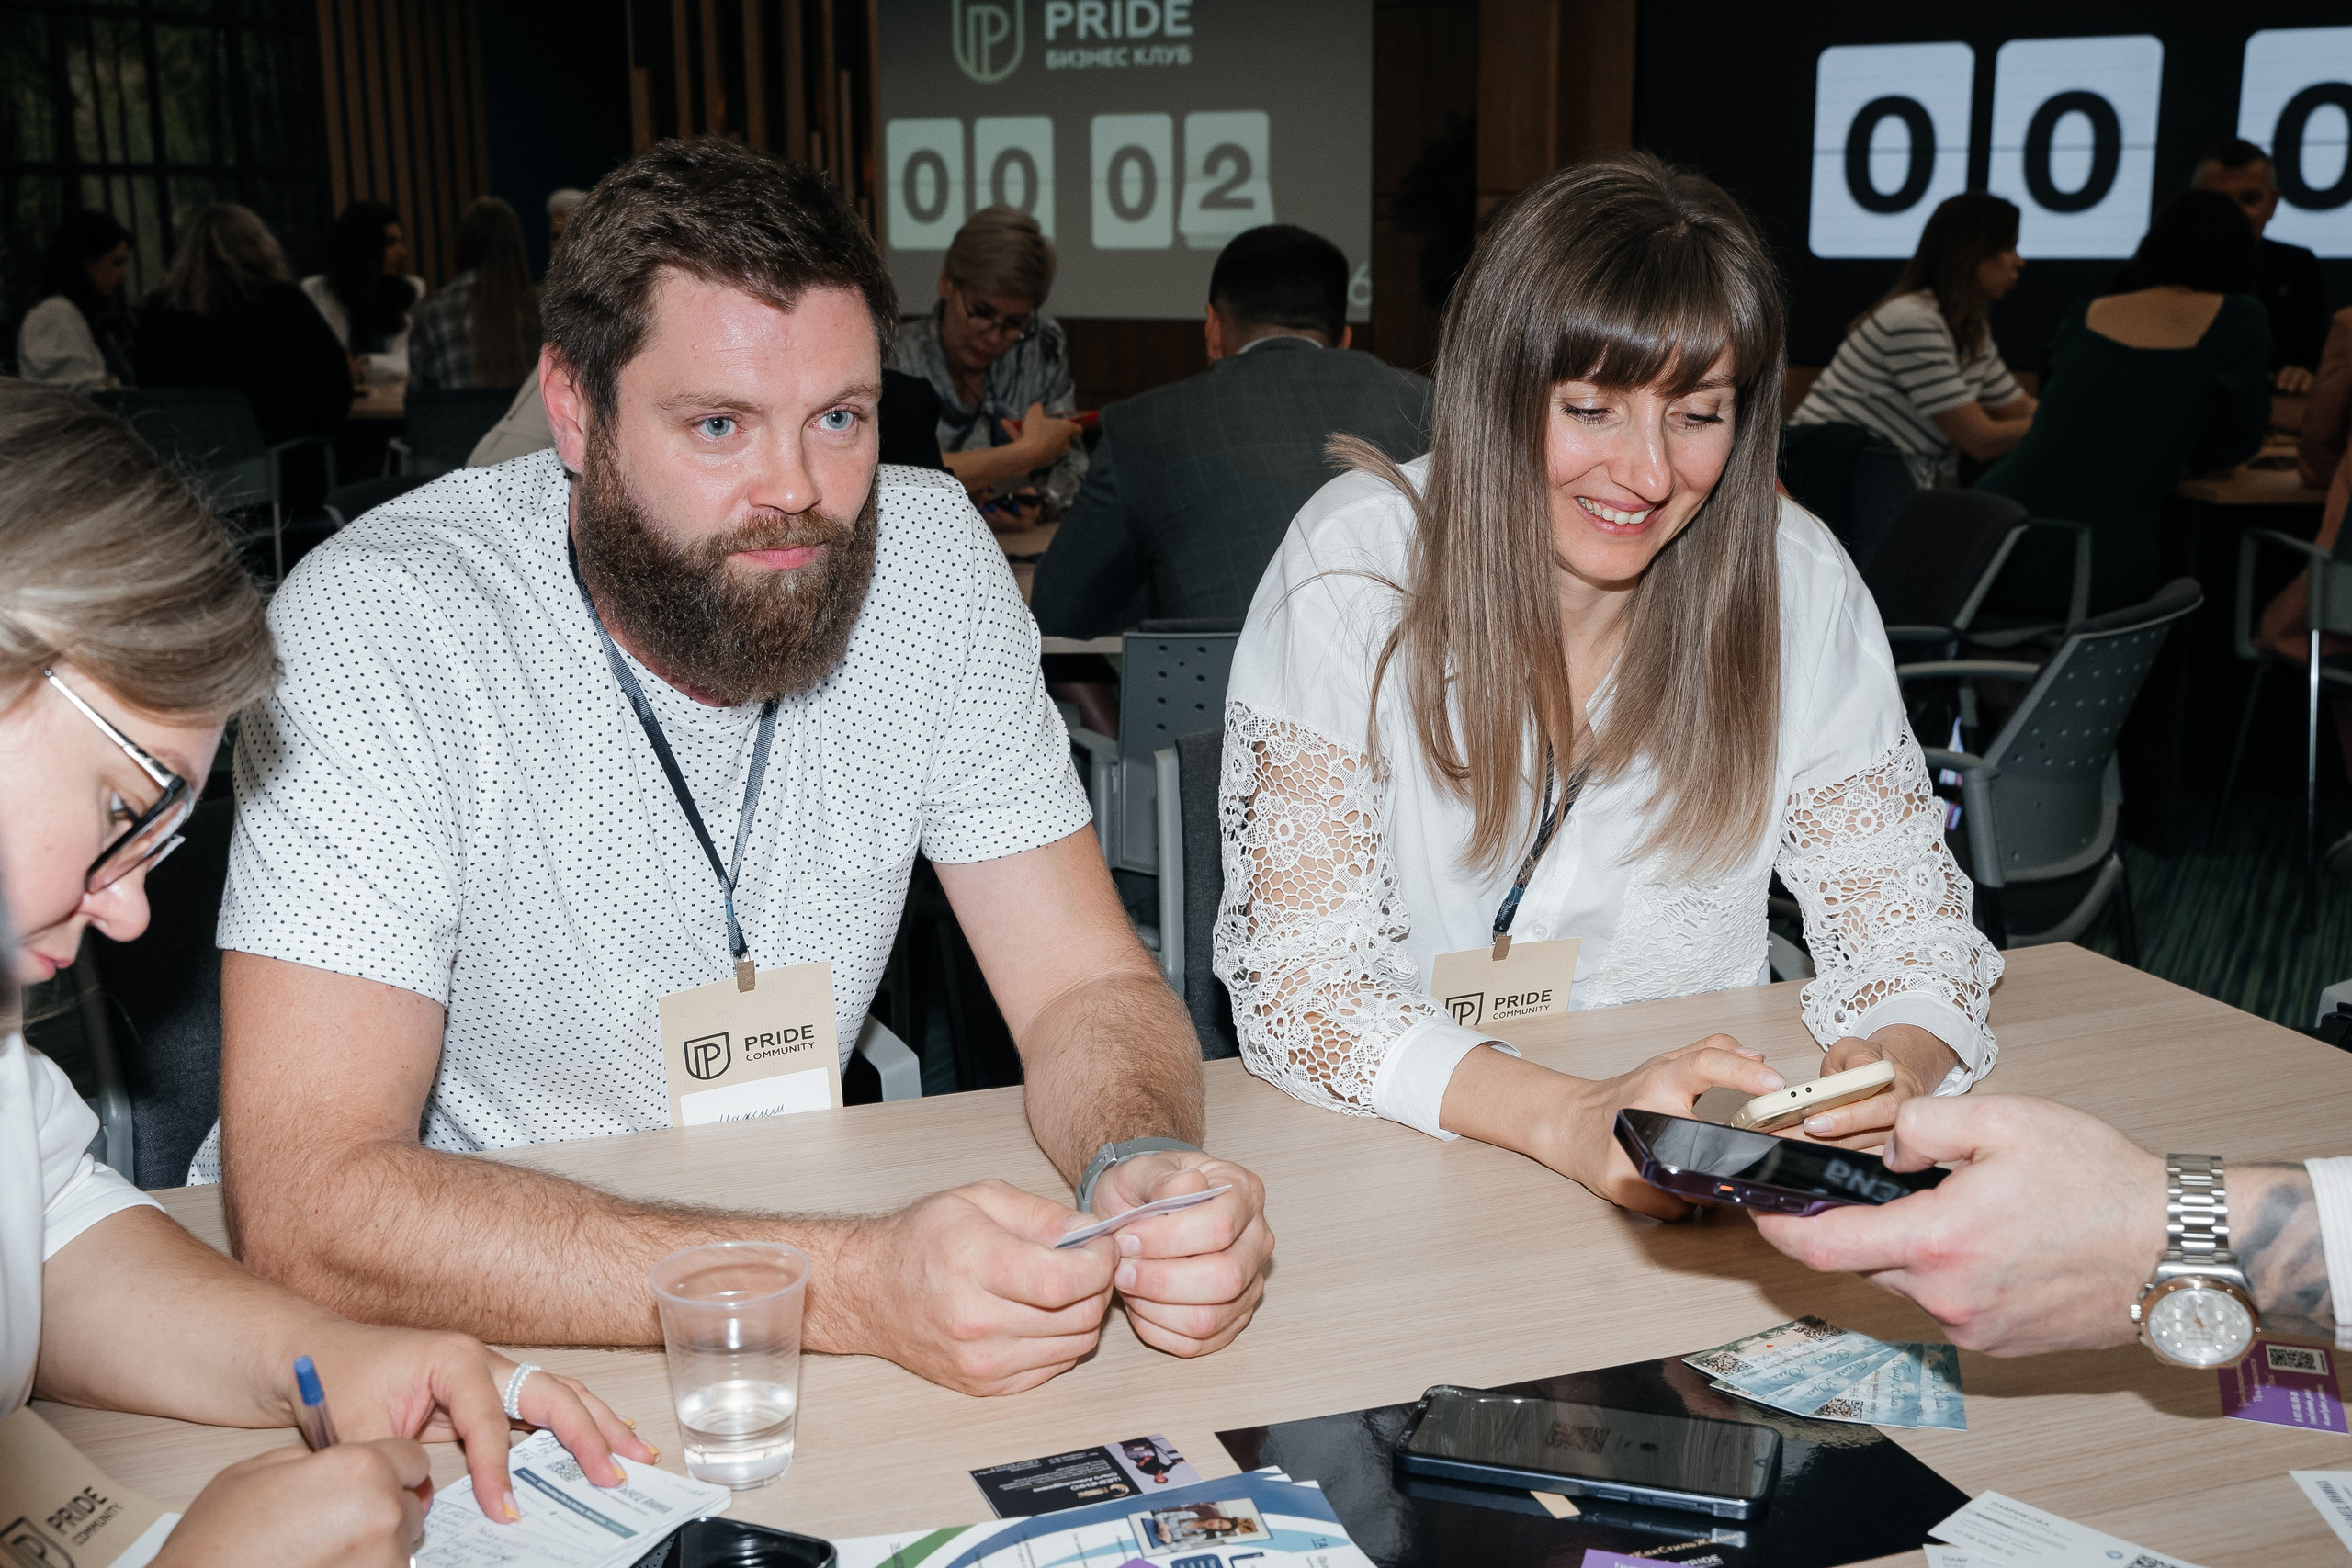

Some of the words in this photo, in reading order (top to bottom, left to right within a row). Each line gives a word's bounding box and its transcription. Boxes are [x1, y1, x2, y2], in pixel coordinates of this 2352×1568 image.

[1045, 0, 1193, 40] PRIDE
[1046, 47, 1129, 70] БИЗНЕС
[1133, 43, 1192, 66] КЛУБ
[1493, 1004, 1550, 1020] COMMUNITY
[1494, 989, 1553, 1010] PRIDE
[744, 1024, 815, 1052] PRIDE
[746, 1041, 815, 1062] COMMUNITY
[47, 1486, 108, 1535] PRIDE
[73, 1503, 124, 1546] COMMUNITY
